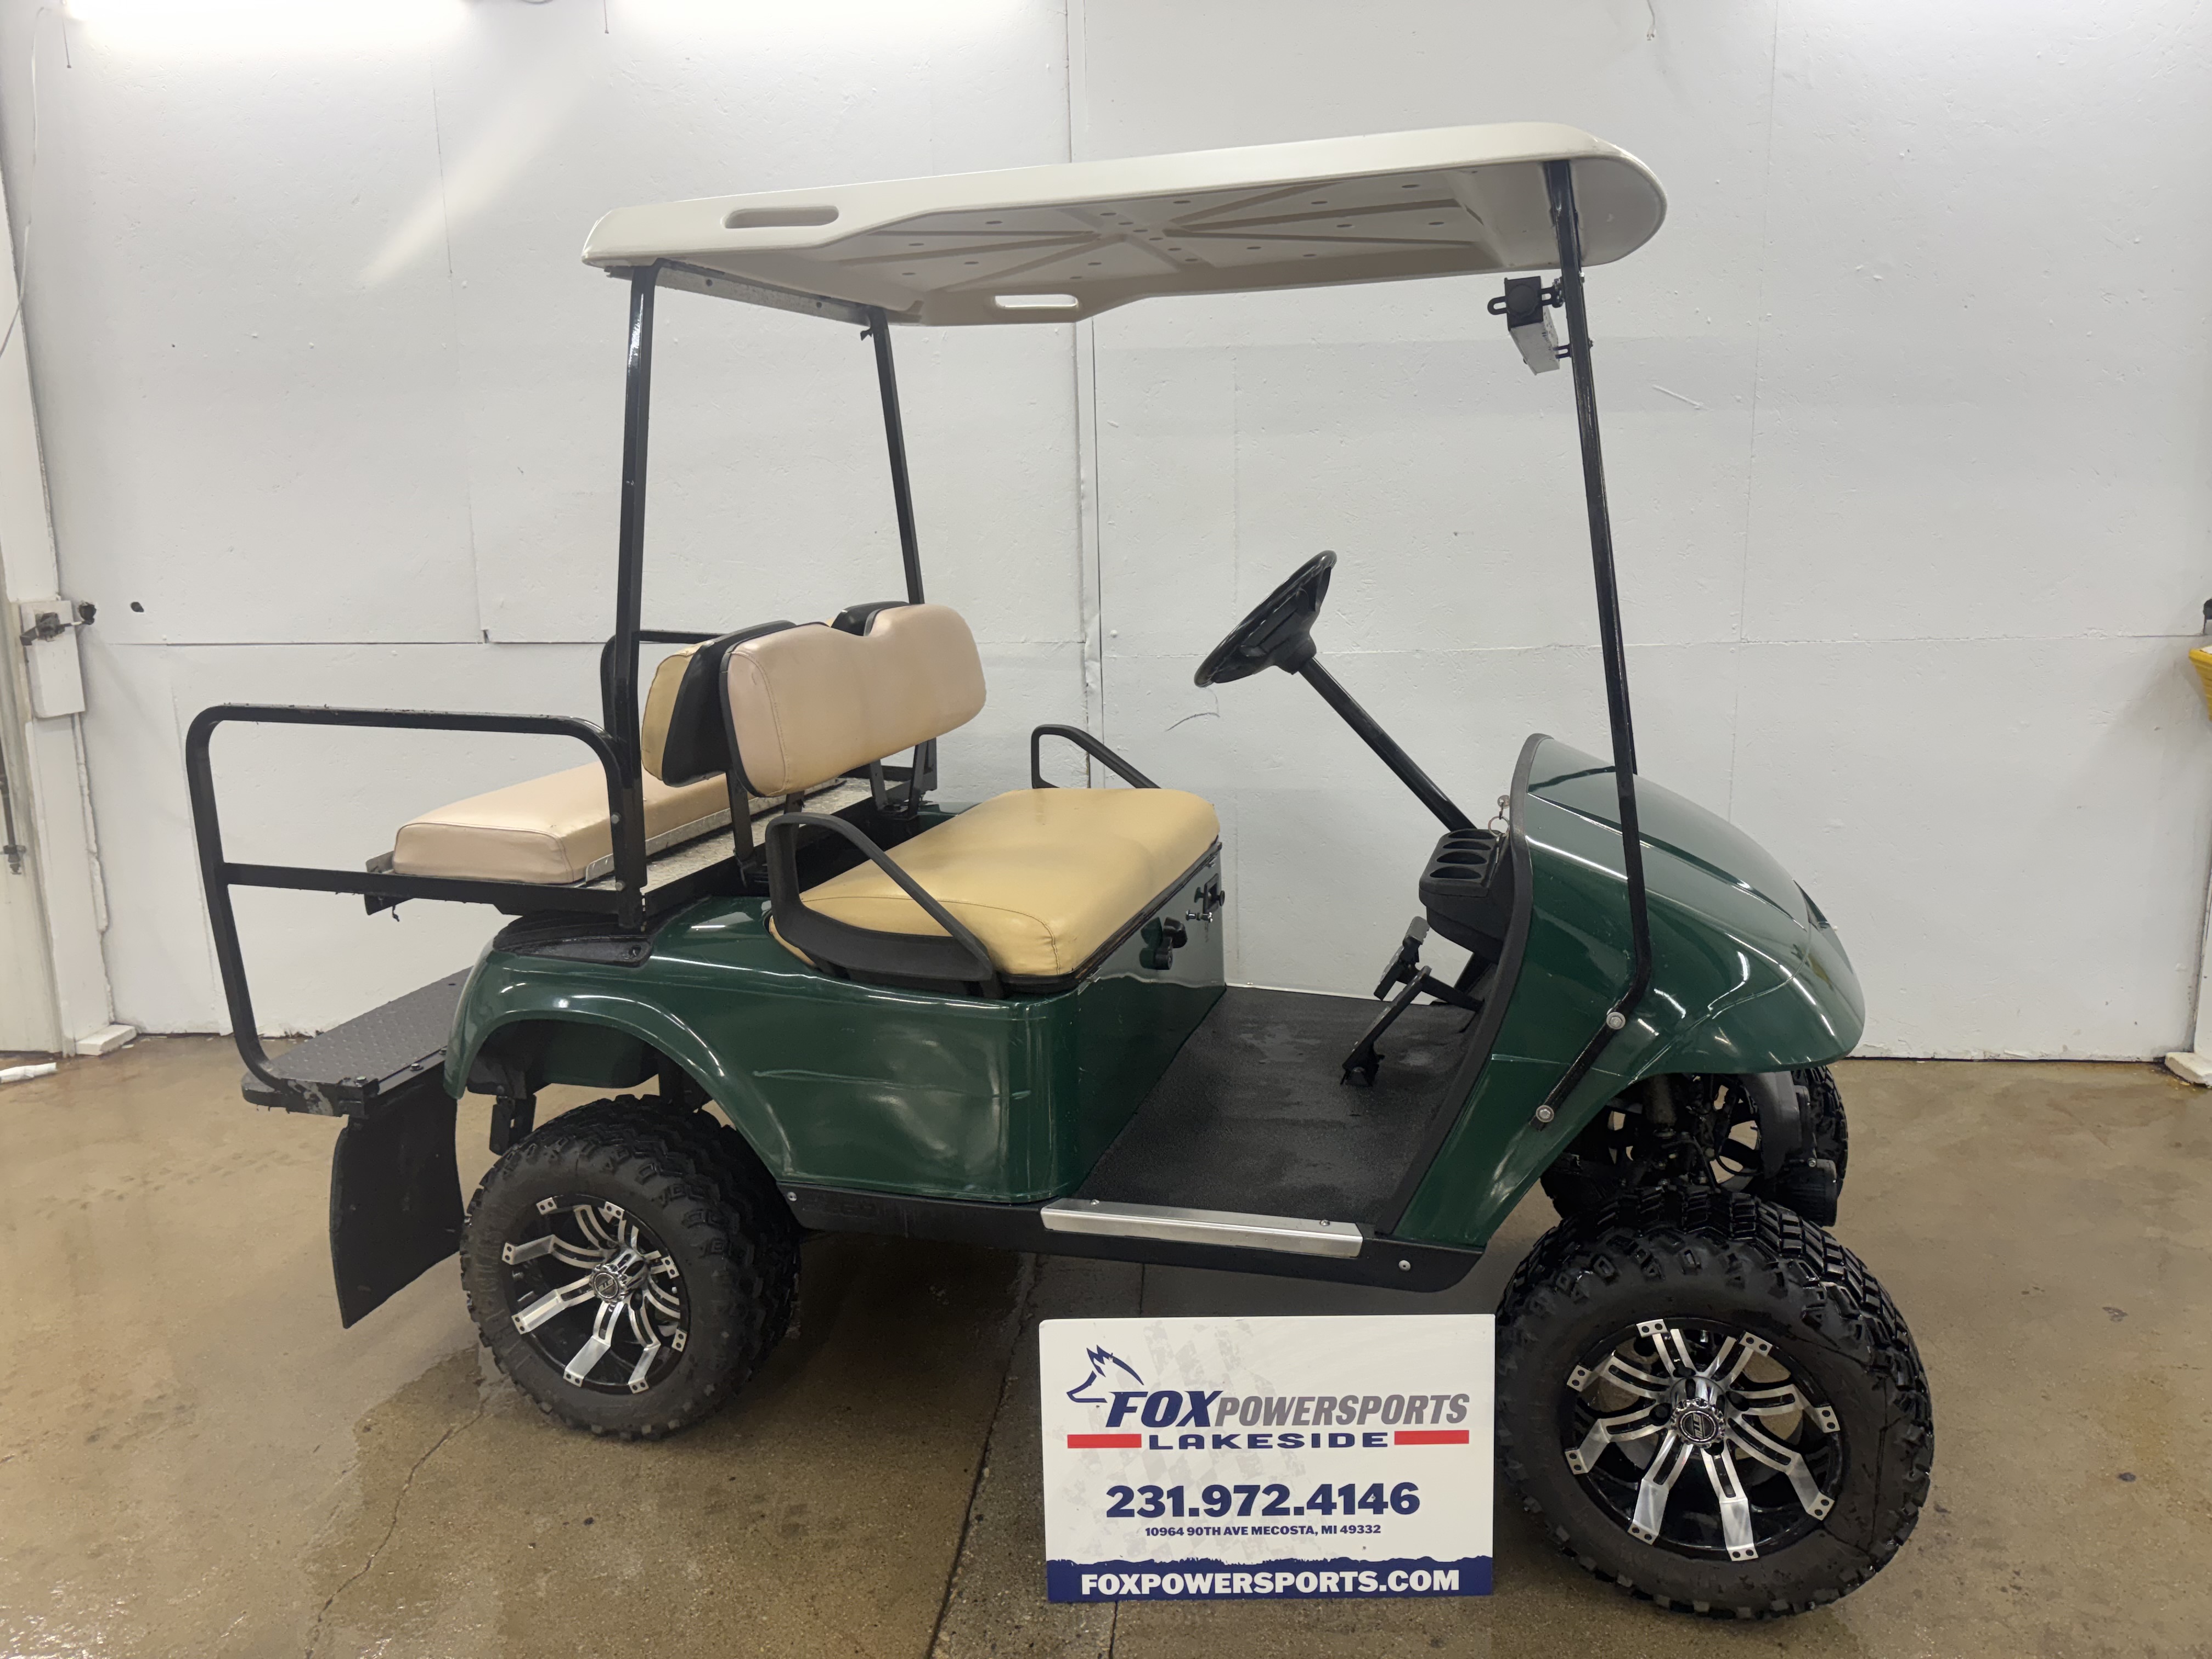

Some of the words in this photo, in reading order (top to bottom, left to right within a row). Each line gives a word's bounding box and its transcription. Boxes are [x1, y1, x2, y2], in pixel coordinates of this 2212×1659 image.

[1692, 1413, 1703, 1439] GTW
[1149, 1432, 1388, 1450] LAKESIDE
[1106, 1482, 1420, 1518] 231.972.4146
[1145, 1527, 1184, 1537] 10964
[1187, 1526, 1221, 1536] 90TH
[1223, 1526, 1249, 1536] AVE
[1251, 1525, 1318, 1536] MECOSTA,
[1321, 1525, 1337, 1534] MI
[1340, 1525, 1381, 1534] 49332
[1081, 1570, 1459, 1595] FOXPOWERSPORTS.COM
